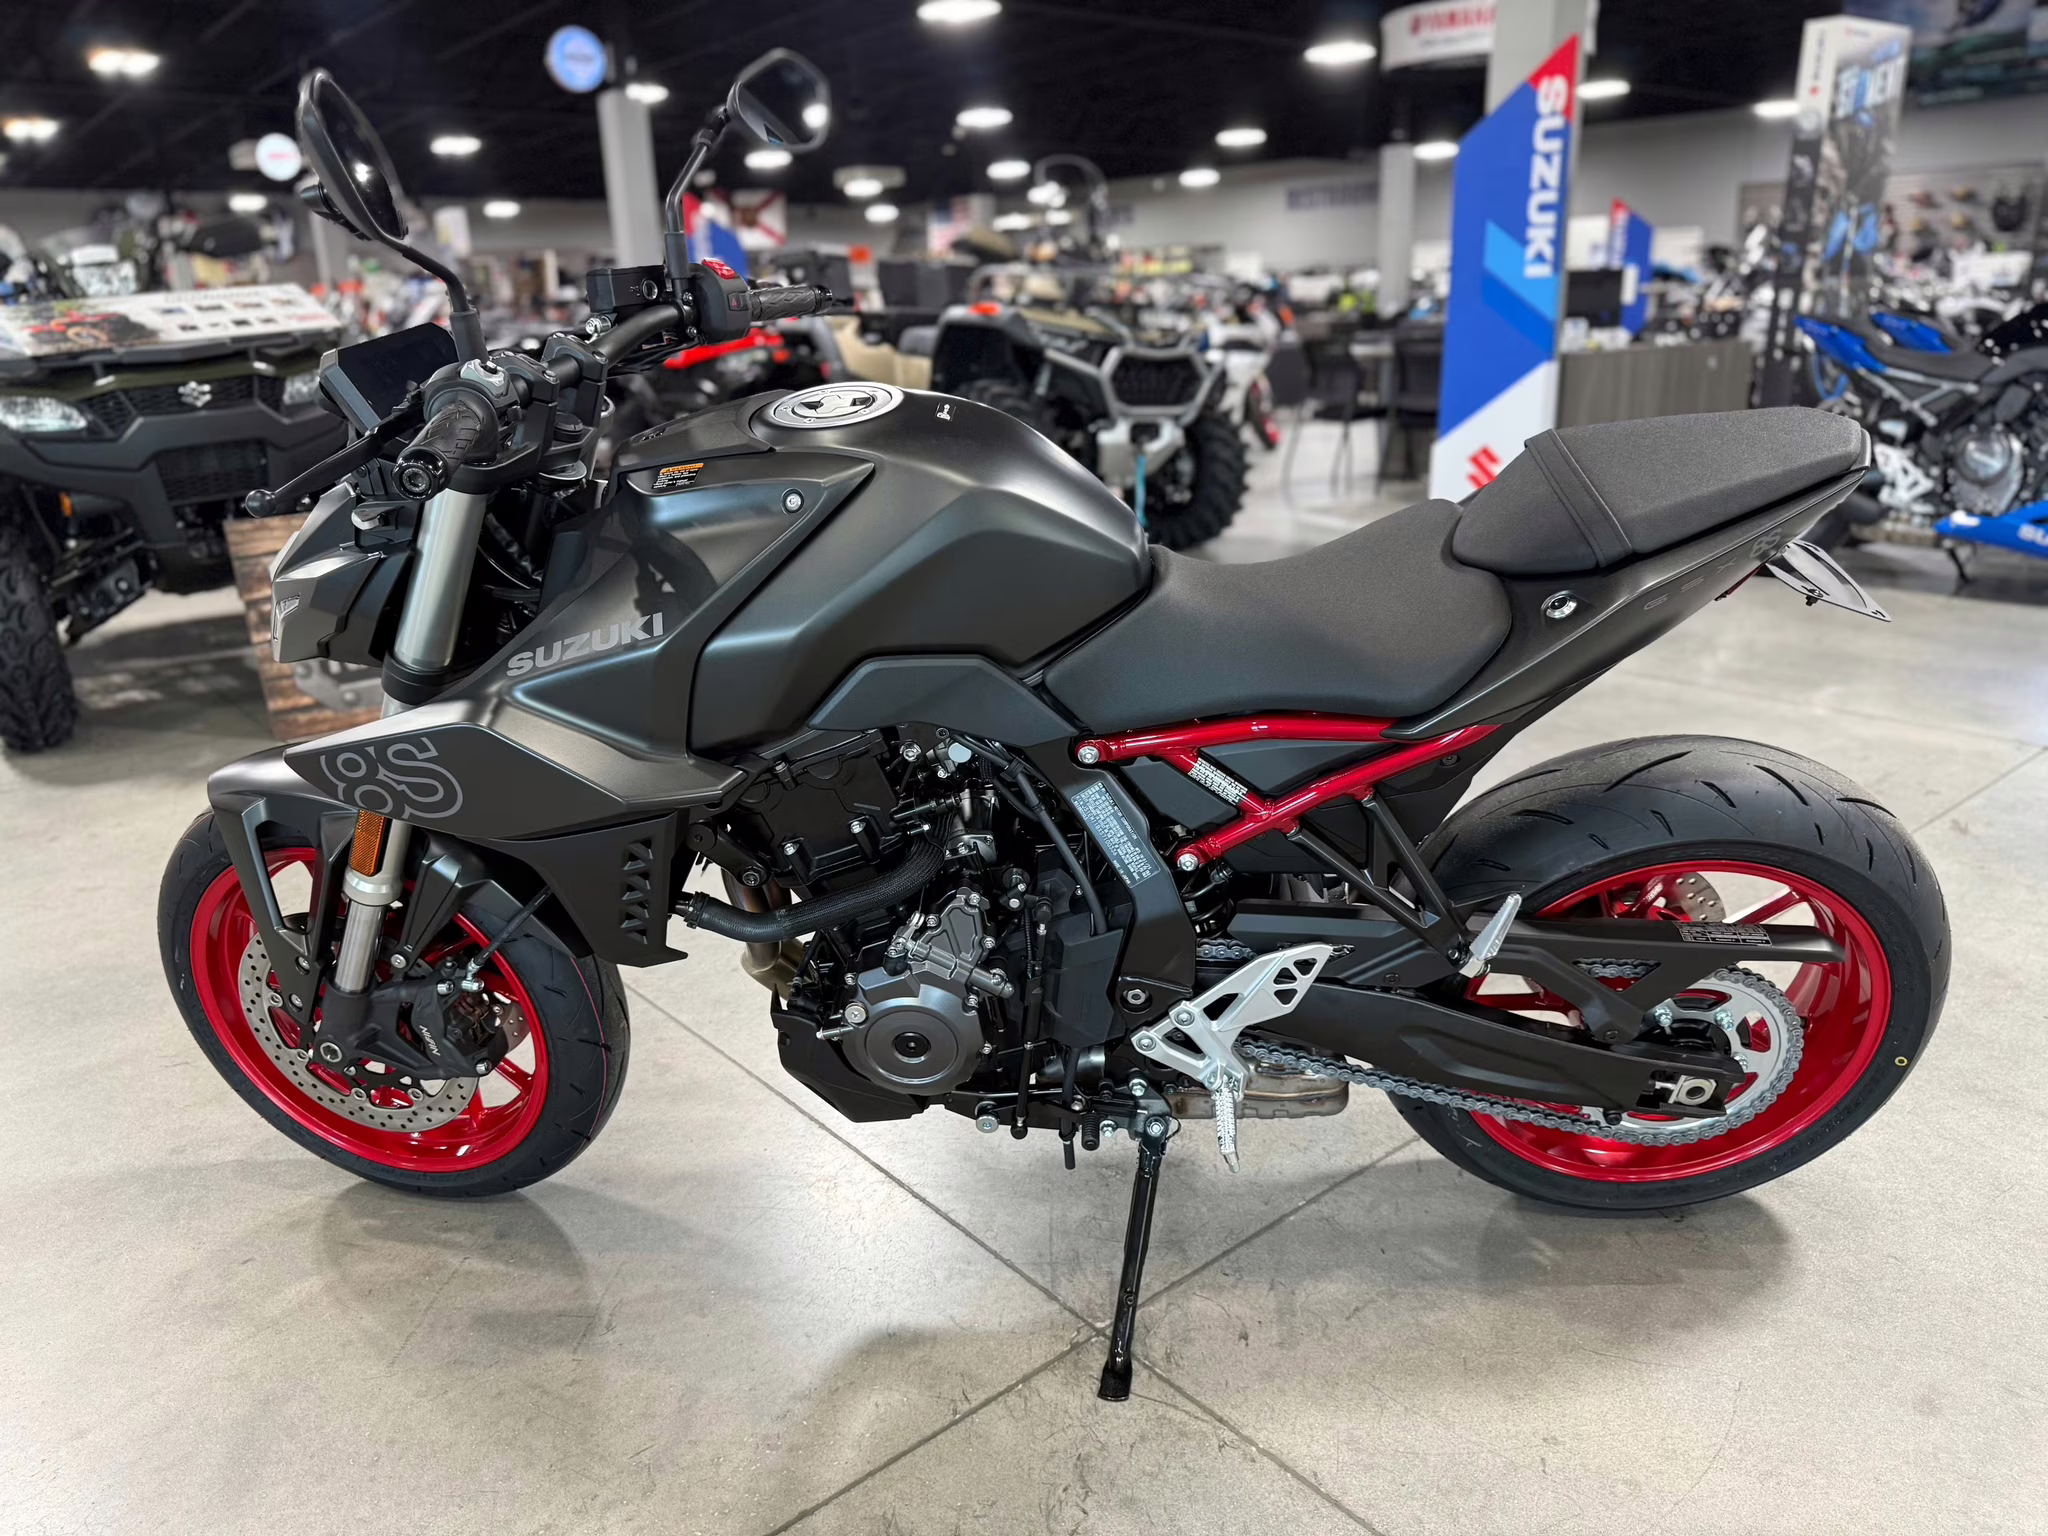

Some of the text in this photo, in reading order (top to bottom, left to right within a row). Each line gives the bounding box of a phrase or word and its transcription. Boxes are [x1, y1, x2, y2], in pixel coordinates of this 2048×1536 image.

[1523, 75, 1568, 278] SUZUKI
[506, 612, 664, 677] SUZUKI
[320, 736, 463, 819] 8S
